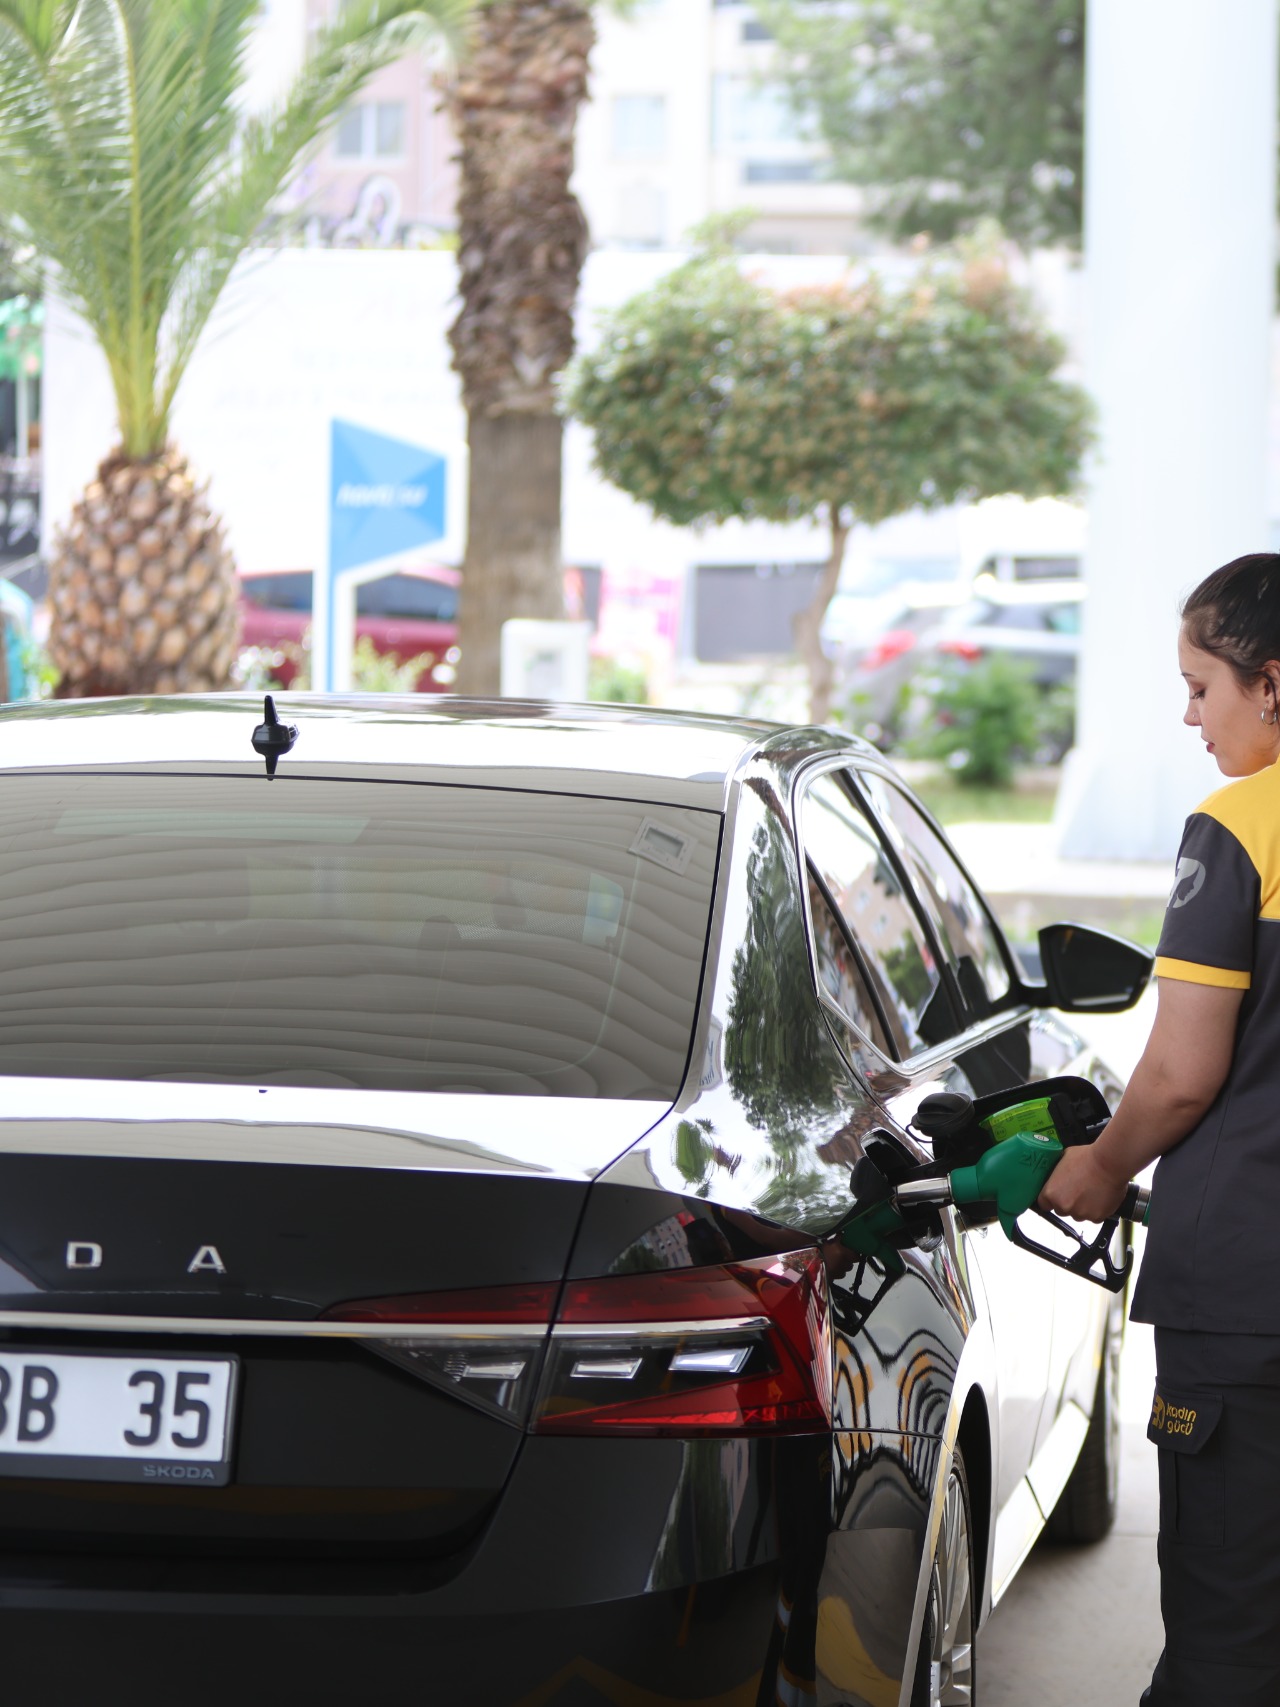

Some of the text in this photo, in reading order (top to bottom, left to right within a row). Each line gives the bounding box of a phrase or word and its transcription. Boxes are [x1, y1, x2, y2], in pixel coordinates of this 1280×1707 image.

[123, 1369, 211, 1449] 35
[1166, 1402, 1197, 1423] kadın
[1167, 1420, 1194, 1436] gücü
